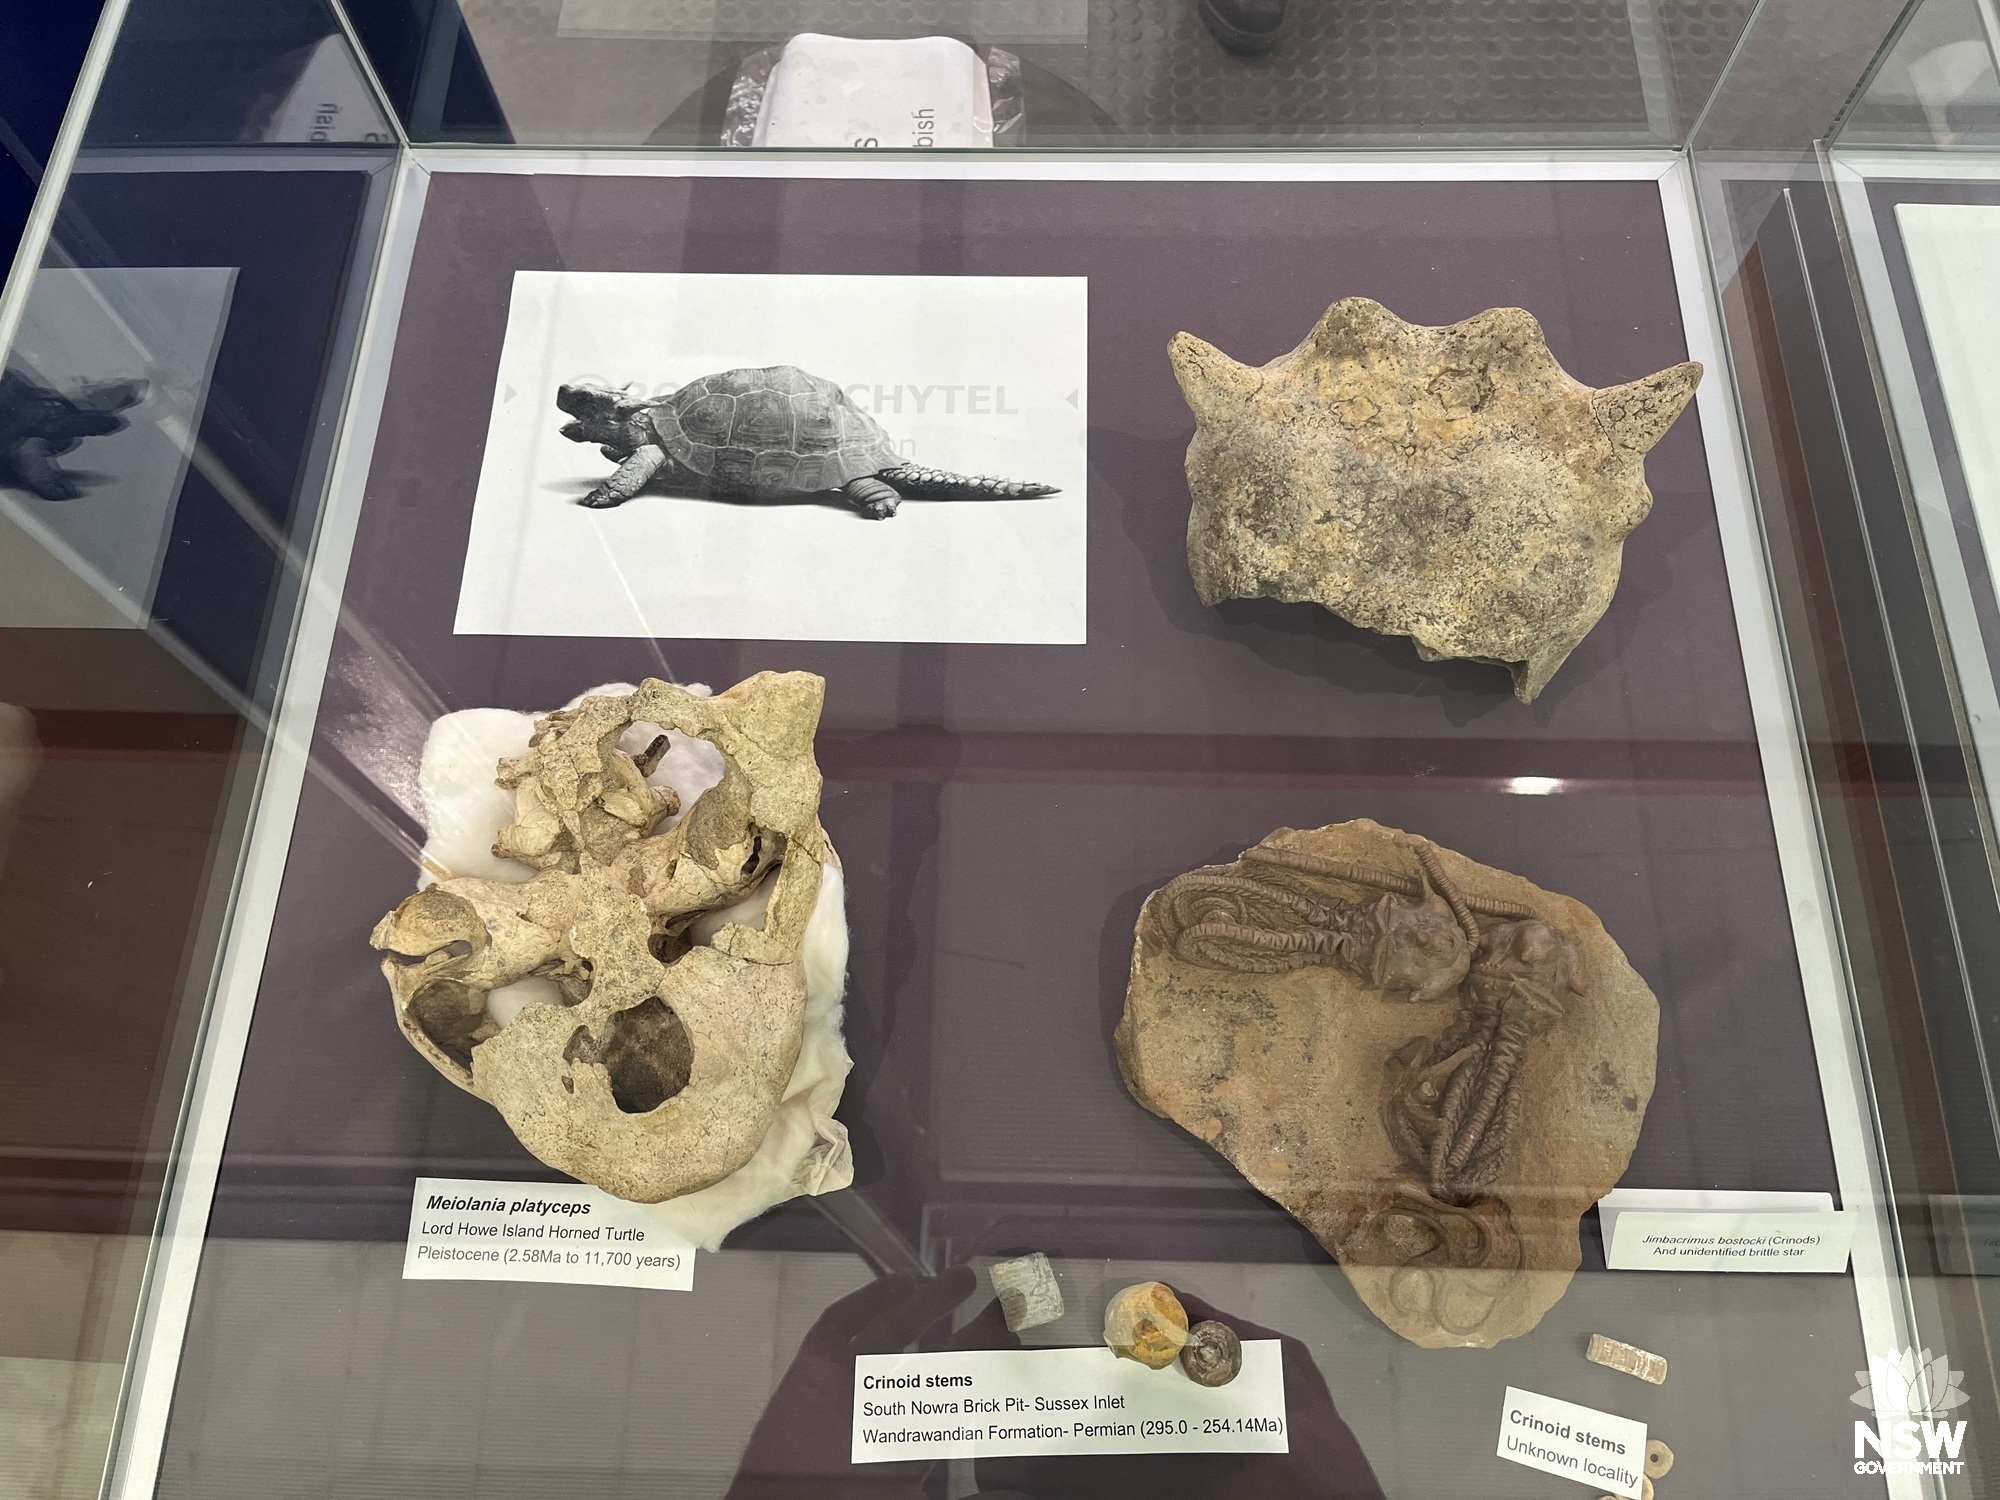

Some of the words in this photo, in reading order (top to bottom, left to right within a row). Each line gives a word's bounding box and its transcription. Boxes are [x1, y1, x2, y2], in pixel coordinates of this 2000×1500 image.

[427, 1196, 506, 1211] Meiolania
[509, 1199, 591, 1217] platyceps
[422, 1222, 453, 1235] Lord
[458, 1222, 497, 1236] Howe
[503, 1224, 544, 1237] Island
[549, 1225, 600, 1239] Horned
[606, 1227, 644, 1241] Turtle
[1769, 1236, 1820, 1246] (Crinods)
[418, 1246, 499, 1261] Pleistocene
[504, 1248, 561, 1265] (2.58Ma
[567, 1252, 579, 1263] to
[586, 1252, 631, 1266] 11,700
[636, 1255, 680, 1270] years)
[1653, 1247, 1676, 1255] And
[1680, 1248, 1746, 1256] unidentified
[864, 1374, 920, 1389] Crinoid
[926, 1375, 972, 1387] stems
[863, 1401, 906, 1416] South
[912, 1401, 958, 1414] Nowra
[964, 1399, 1000, 1413] Brick
[1006, 1398, 1029, 1411] Pit-
[1035, 1397, 1089, 1411] Sussex
[1094, 1395, 1125, 1409] Inlet
[863, 1426, 984, 1443] Wandrawandian
[989, 1424, 1068, 1439] Formation-
[1074, 1422, 1135, 1437] Permian
[1141, 1420, 1187, 1439] (295.0
[1202, 1417, 1284, 1435] 254.14Ma)
[1511, 1410, 1570, 1438] Crinoid
[1576, 1432, 1625, 1454] stems
[1507, 1435, 1578, 1469] Unknown
[1583, 1458, 1638, 1488] locality
